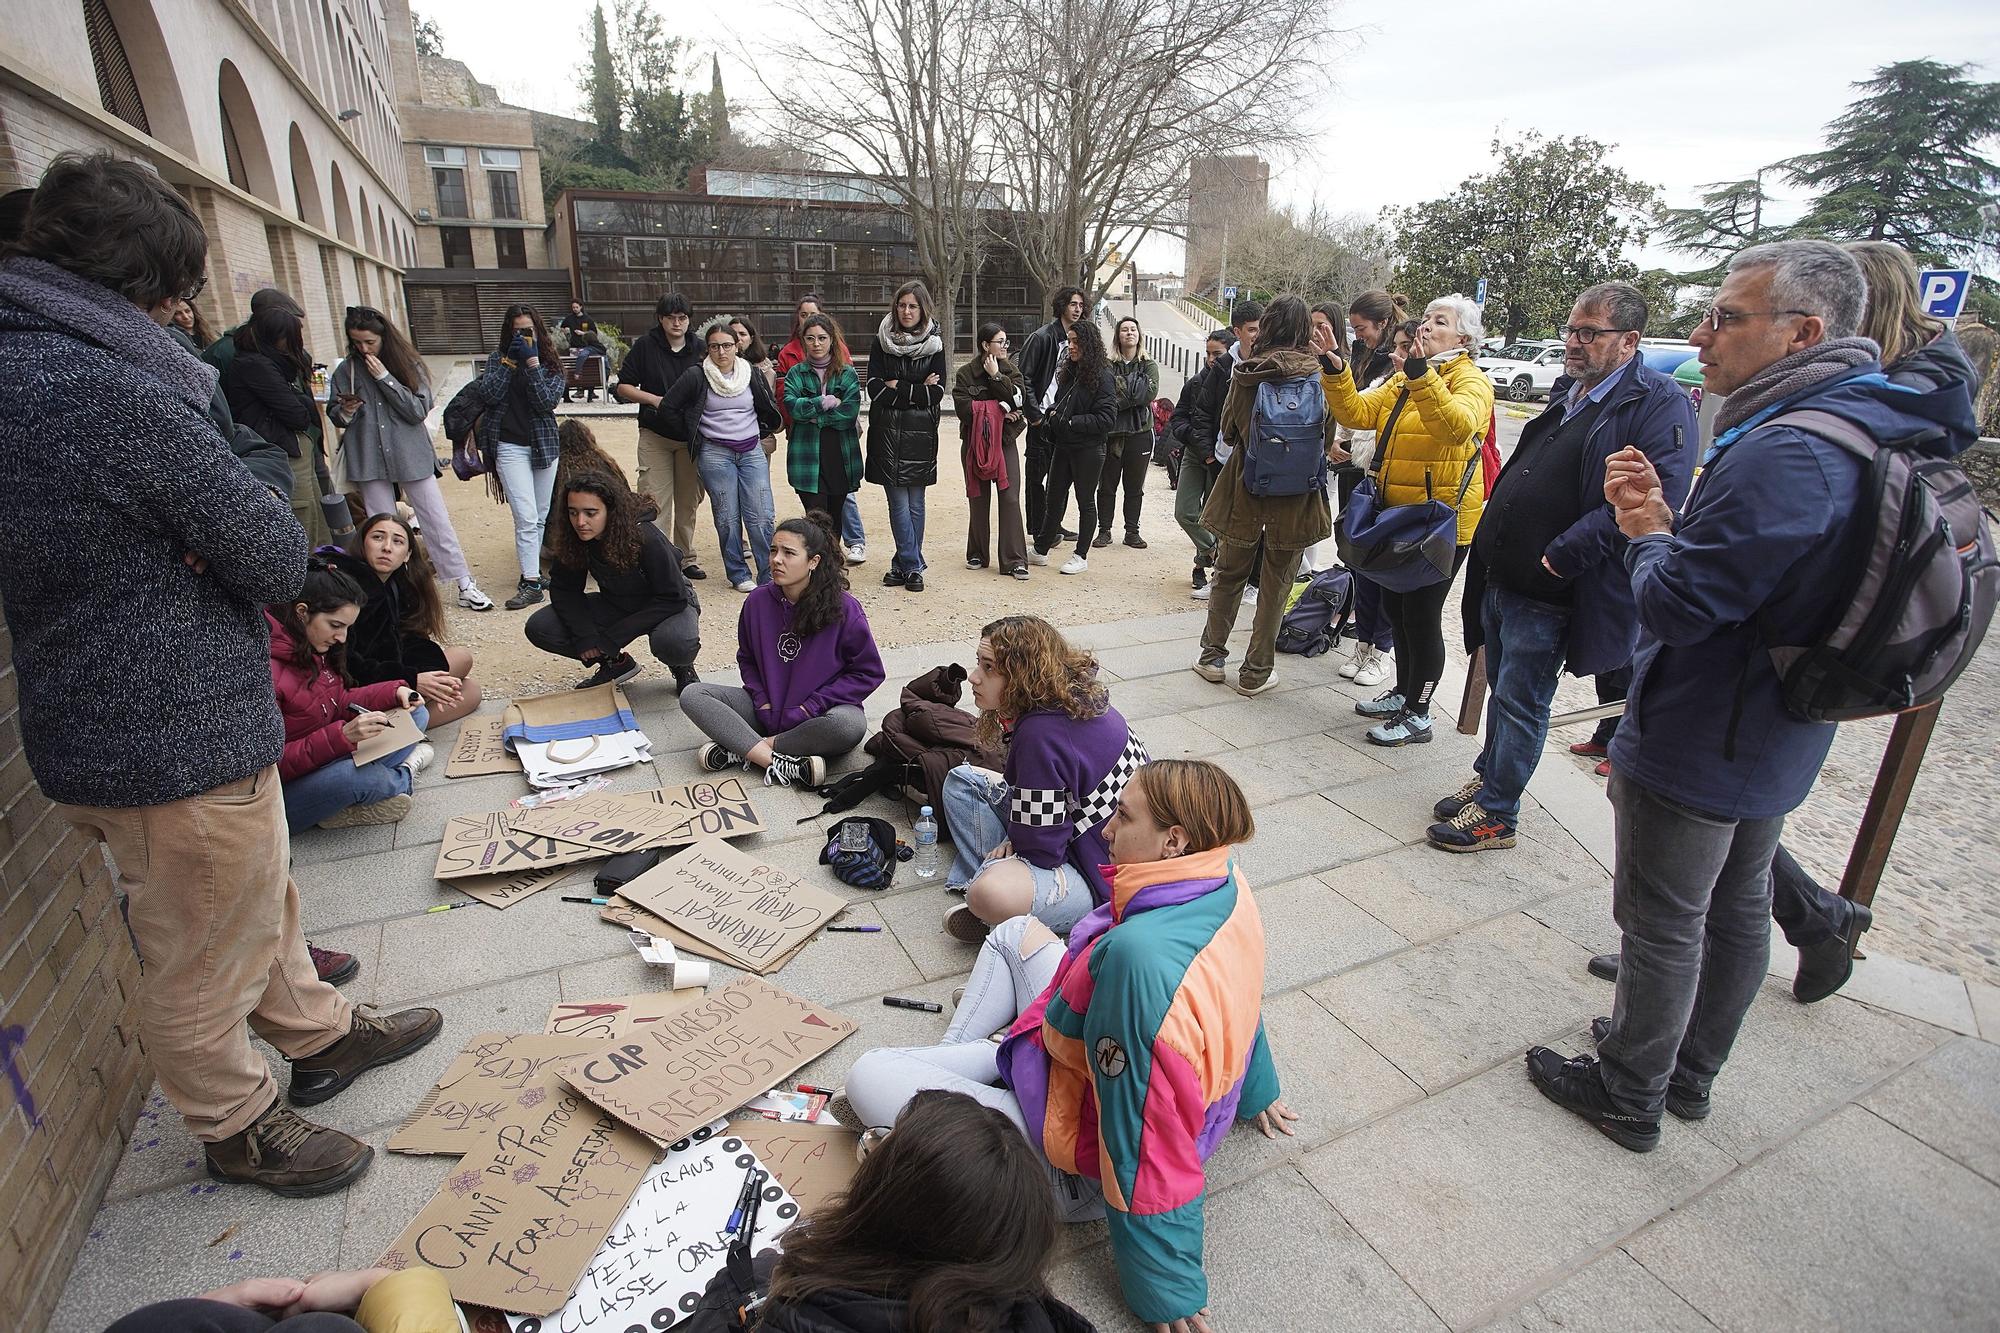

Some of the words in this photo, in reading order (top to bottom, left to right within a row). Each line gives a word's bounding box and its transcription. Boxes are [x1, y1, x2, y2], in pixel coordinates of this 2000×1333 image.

[1921, 276, 1956, 312] P
[1418, 681, 1434, 704] PUMA
[481, 747, 502, 763] ALS
[700, 803, 760, 834] NO
[589, 828, 646, 849] NO
[583, 1044, 649, 1084] CAP
[665, 1024, 760, 1082] SENSE
[486, 1153, 516, 1177] DE
[642, 1154, 715, 1193] TRANS
[654, 1200, 690, 1224] LA
[487, 1215, 554, 1276] FORA
[586, 1231, 682, 1290] TEIXA
[560, 1272, 668, 1333] CLASSE
